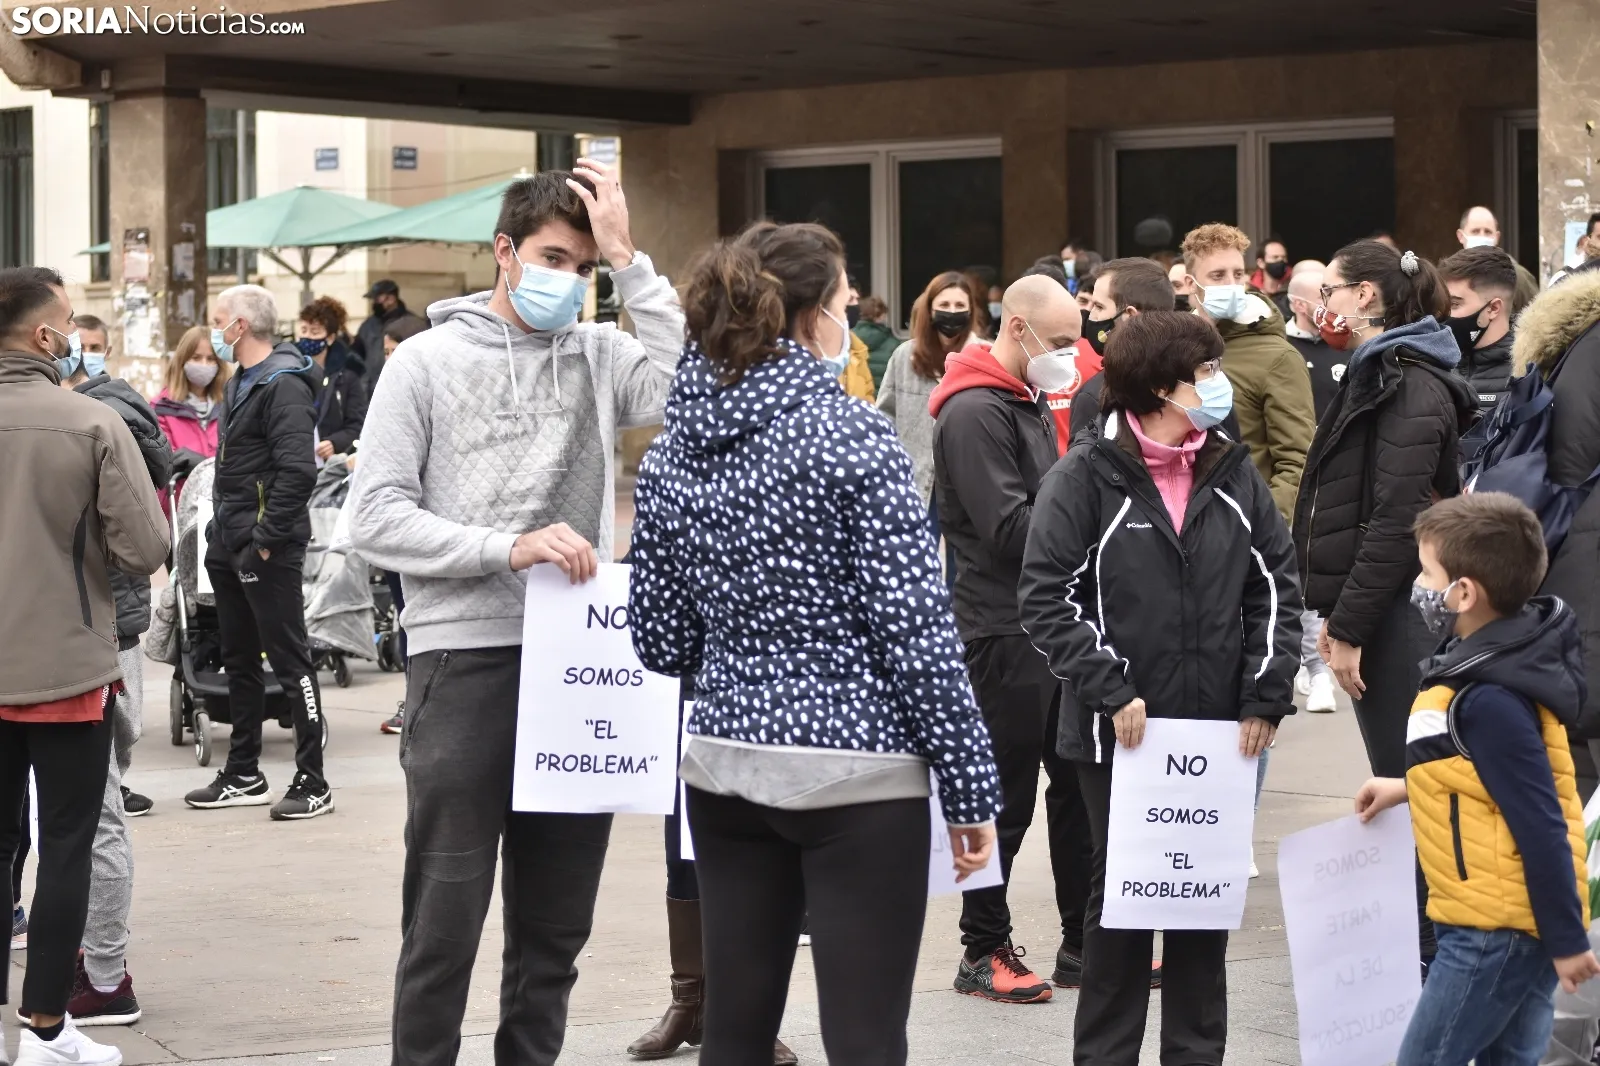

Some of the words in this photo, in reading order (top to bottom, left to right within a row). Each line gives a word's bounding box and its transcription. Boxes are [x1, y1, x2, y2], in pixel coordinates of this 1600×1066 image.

[587, 603, 631, 630] NO
[563, 666, 644, 687] SOMOS
[585, 718, 619, 740] “EL
[535, 752, 659, 775] PROBLEMA”
[1166, 753, 1208, 777] NO
[1145, 807, 1219, 825] SOMOS
[1164, 852, 1194, 870] “EL
[1121, 880, 1231, 899] PROBLEMA”
